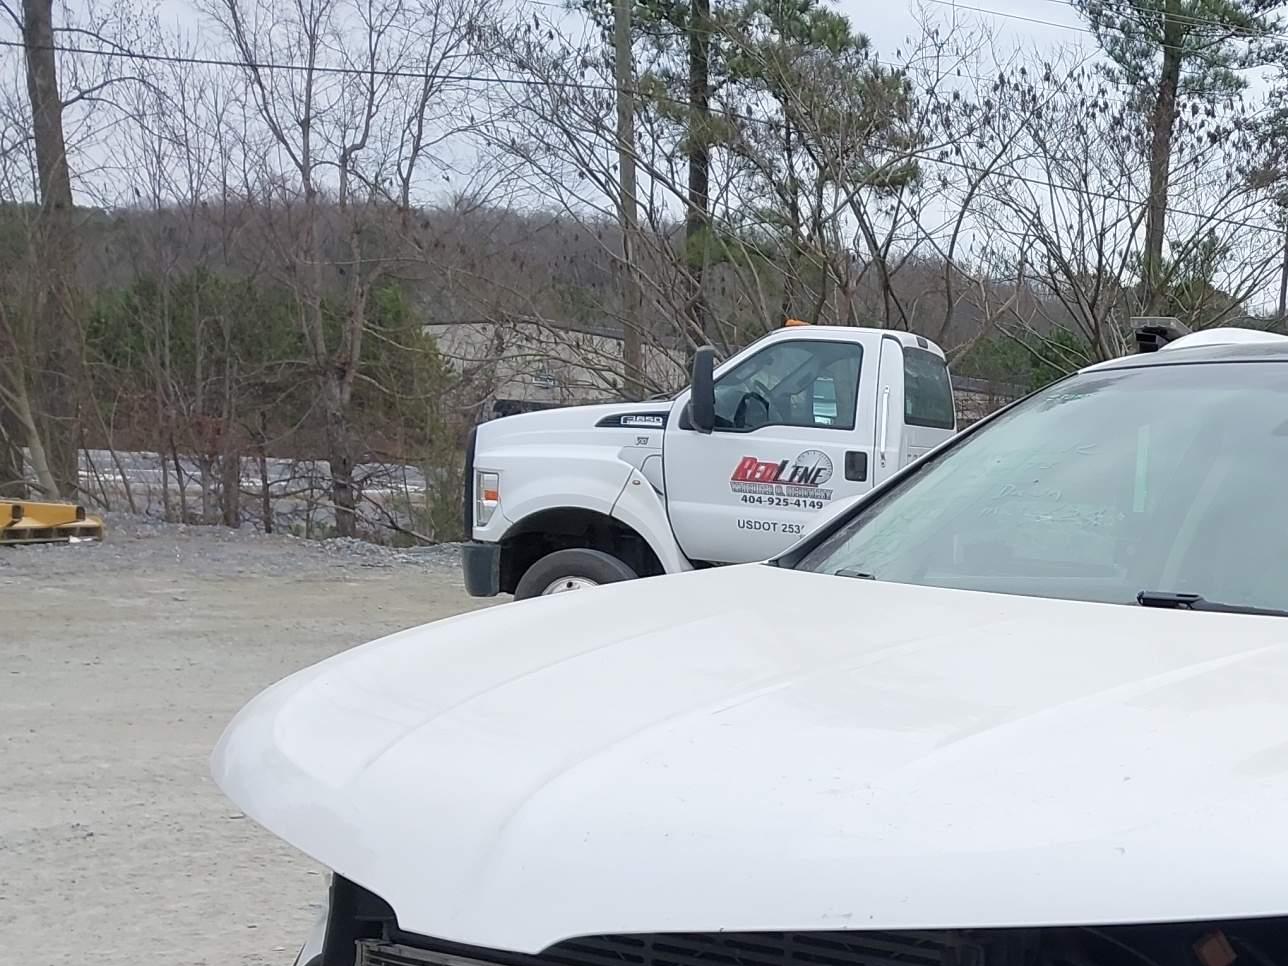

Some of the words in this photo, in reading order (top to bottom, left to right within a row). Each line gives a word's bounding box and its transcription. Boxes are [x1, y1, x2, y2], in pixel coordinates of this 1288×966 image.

[741, 494, 824, 510] 404-925-4149
[737, 519, 779, 532] USDOT
[781, 523, 805, 534] 253
